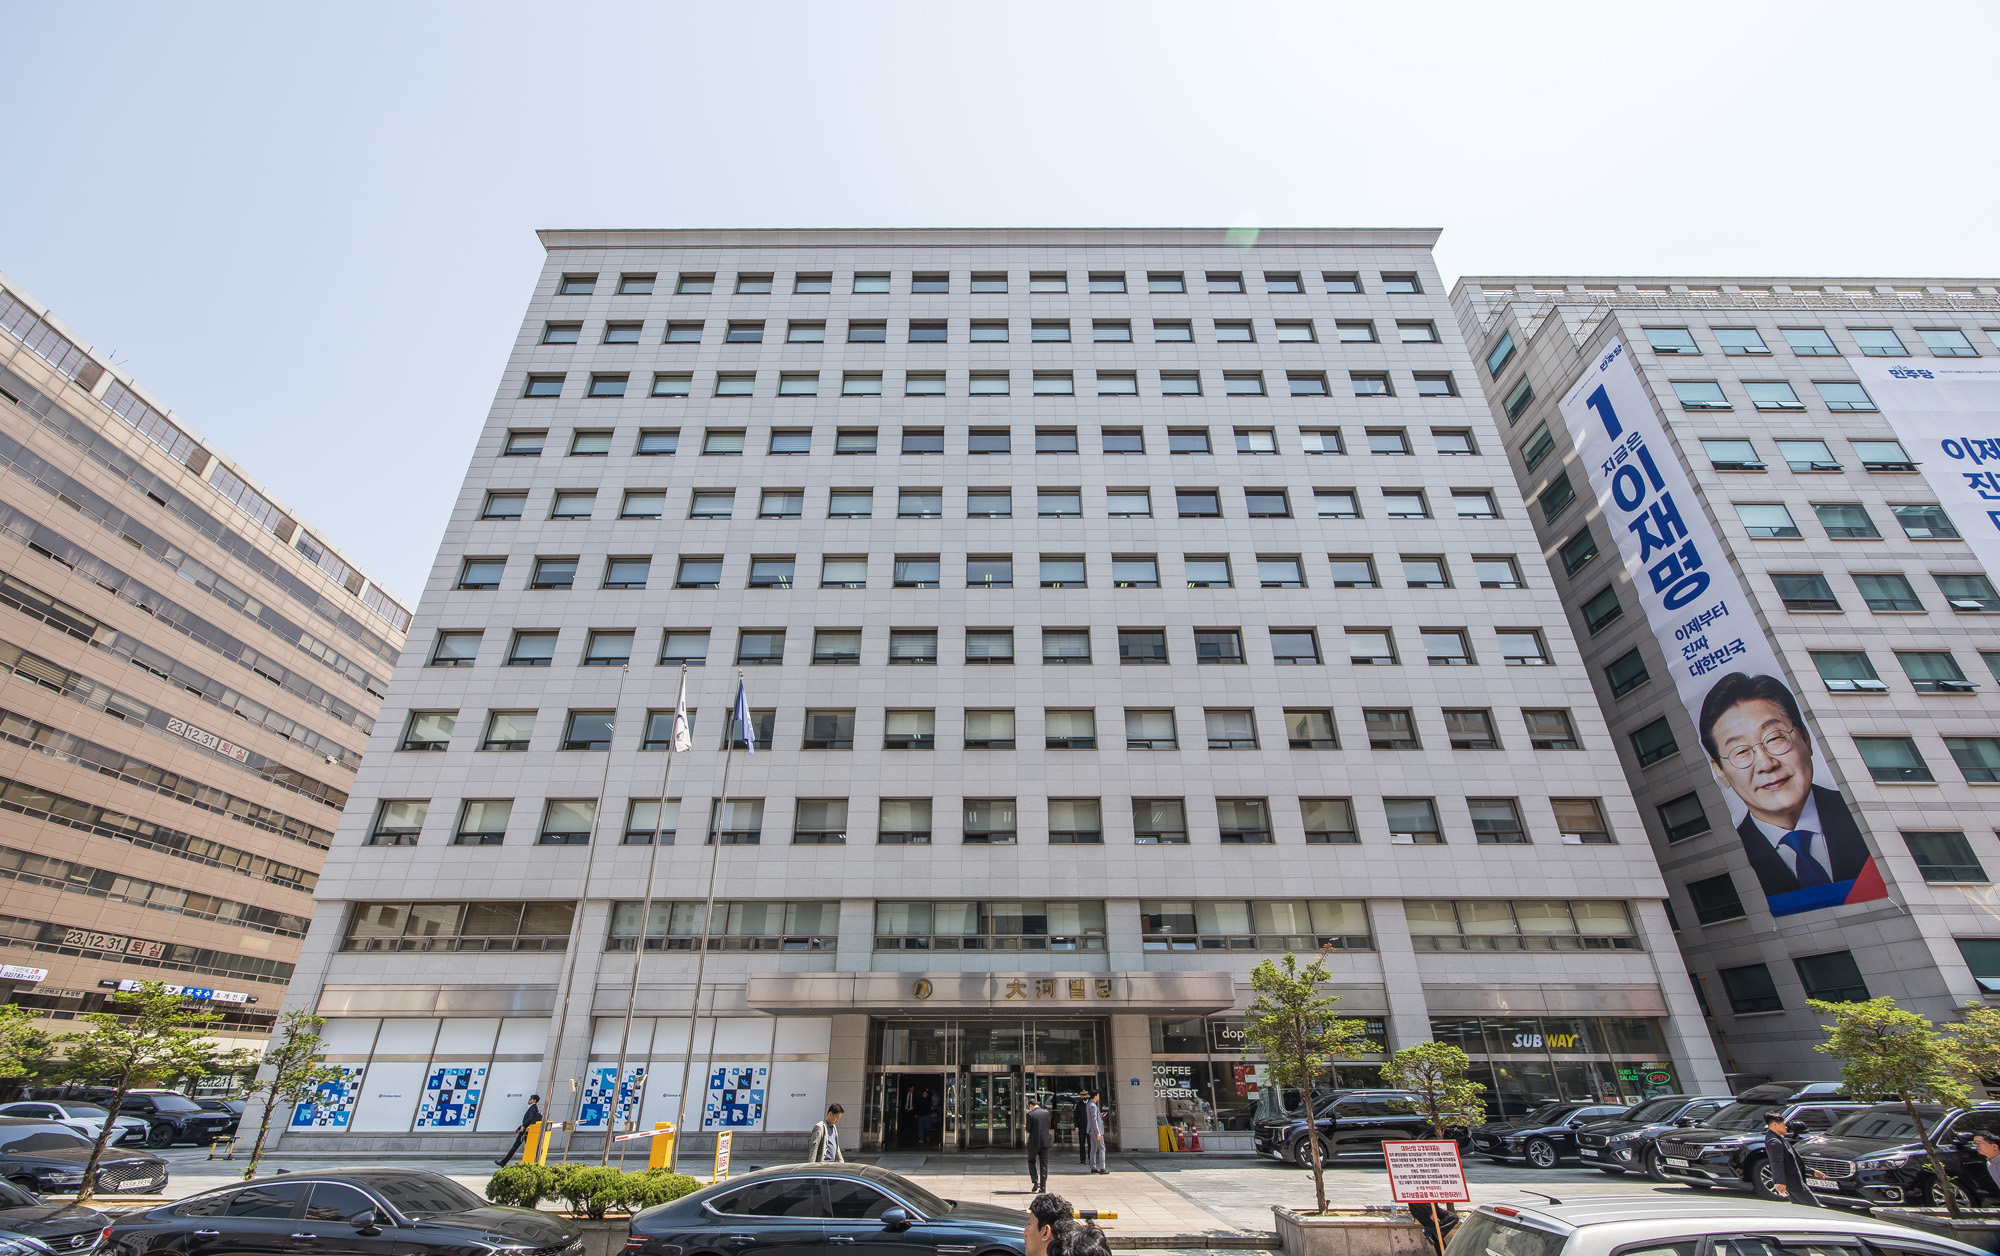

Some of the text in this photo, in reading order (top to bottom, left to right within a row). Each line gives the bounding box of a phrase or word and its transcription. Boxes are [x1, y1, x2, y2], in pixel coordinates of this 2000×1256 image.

[1600, 345, 1622, 372] 민주당
[1888, 369, 1935, 379] 민주당
[1586, 383, 1623, 442] 1
[1601, 431, 1643, 477] 지금은
[1962, 471, 2000, 500] 진
[1611, 443, 1711, 611] 이재명
[1675, 600, 1729, 640] 이제부터
[1681, 635, 1709, 661] 진짜
[1688, 638, 1746, 677] 대한민국
[1222, 1026, 1248, 1041] dop
[1512, 1034, 1579, 1048] SUBWAY
[1152, 1066, 1191, 1075] COFFEE
[1641, 1062, 1669, 1070] SUBWAY
[1154, 1078, 1176, 1086] AND
